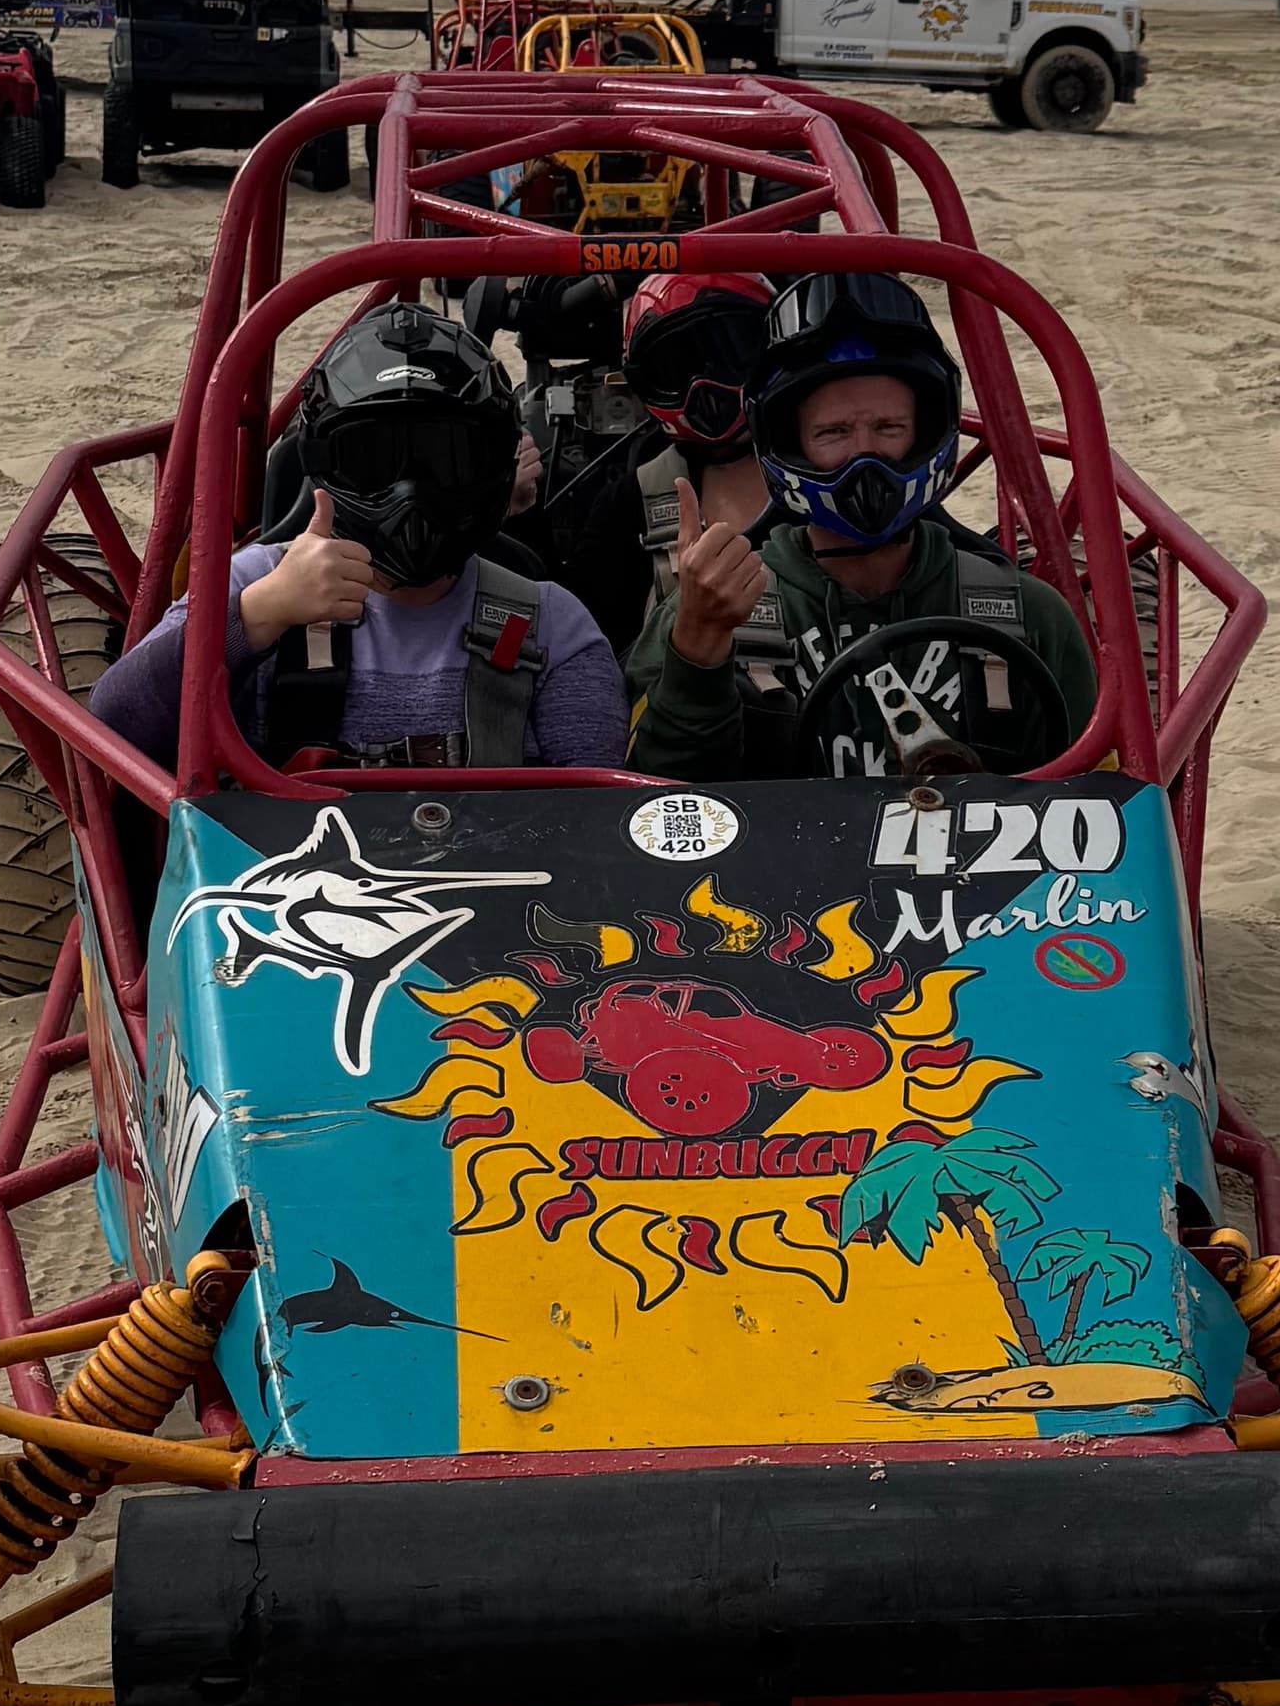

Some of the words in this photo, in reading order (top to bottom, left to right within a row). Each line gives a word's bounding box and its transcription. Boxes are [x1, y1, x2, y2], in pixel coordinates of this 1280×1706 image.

[583, 242, 678, 271] SB420
[662, 799, 700, 813] SB
[660, 838, 706, 854] 420
[872, 796, 1125, 877] 420
[881, 873, 1148, 955] Marlin
[561, 1130, 875, 1181] SUNBUGGY
